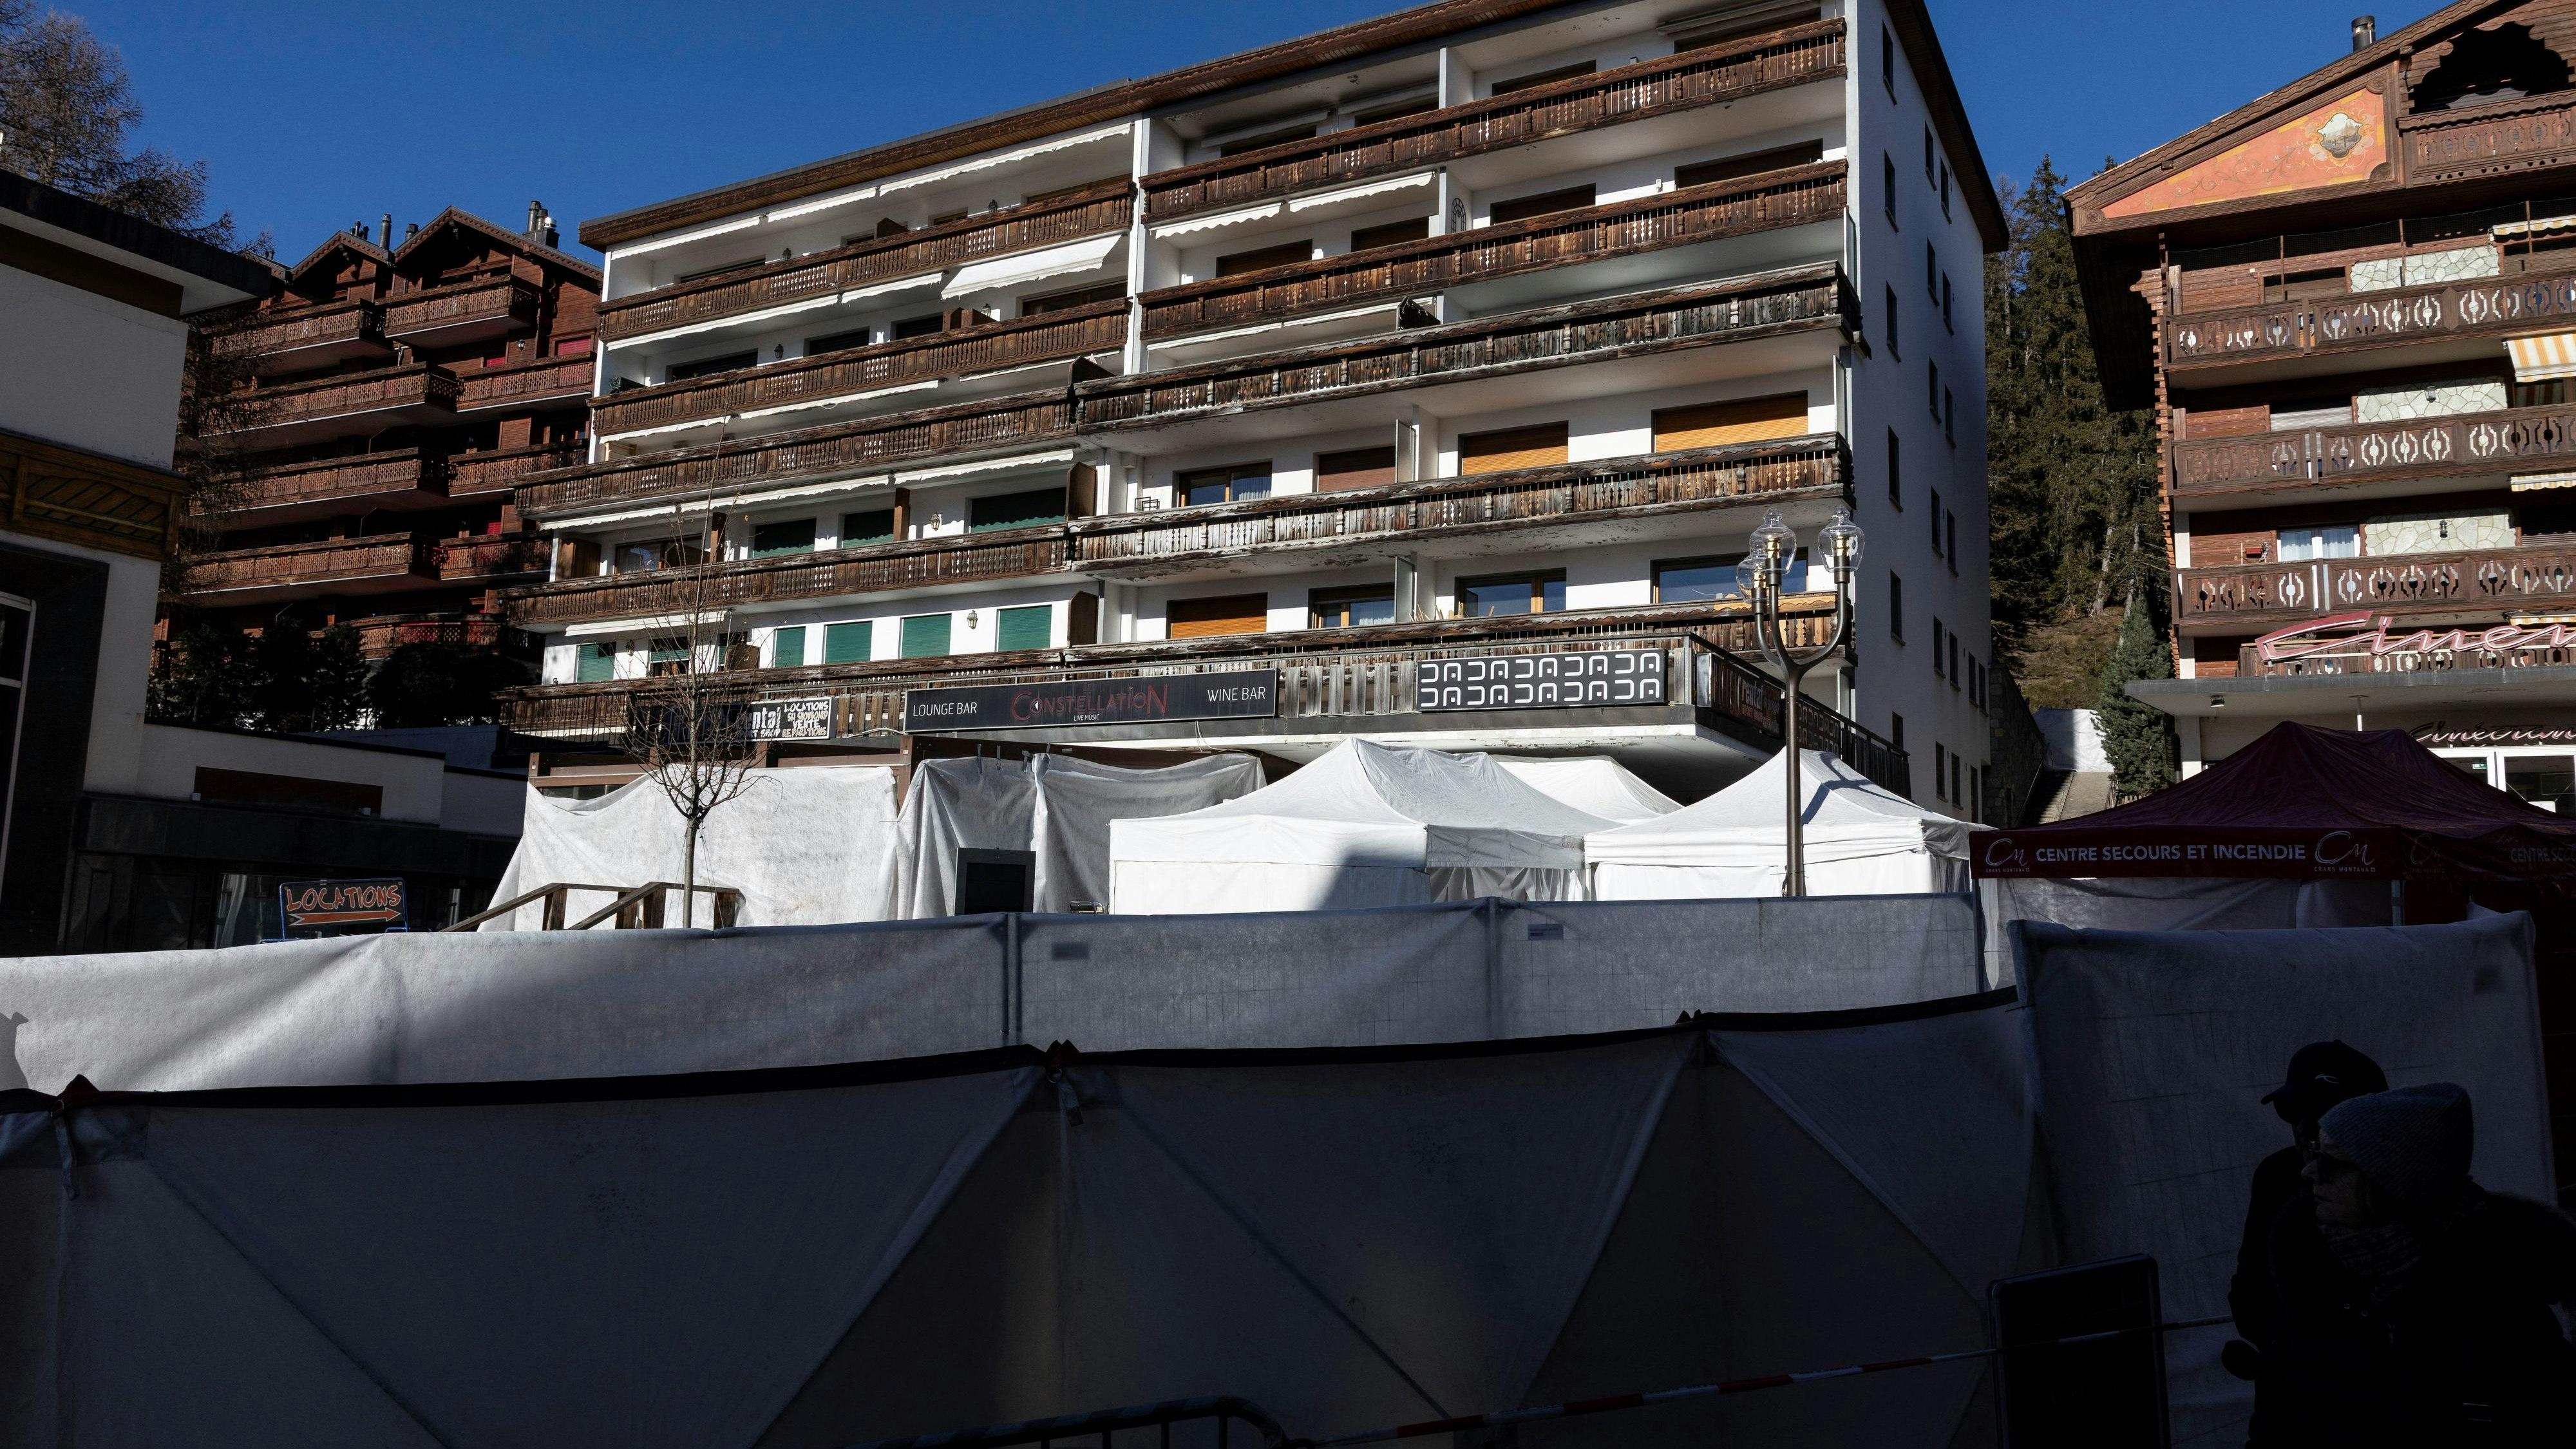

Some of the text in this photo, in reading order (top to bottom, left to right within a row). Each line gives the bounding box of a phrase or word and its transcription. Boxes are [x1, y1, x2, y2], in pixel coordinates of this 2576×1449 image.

[1207, 687, 1265, 702] WINE BAR
[784, 701, 829, 713] LOCATIONS
[913, 702, 977, 717] LOUNGE BAR
[793, 718, 820, 729] VENTE
[782, 727, 827, 737] REPARATIONS
[2036, 844, 2306, 862] CENTRE SECOURS ET INCENDIE
[286, 885, 402, 912] LOCATIONS
